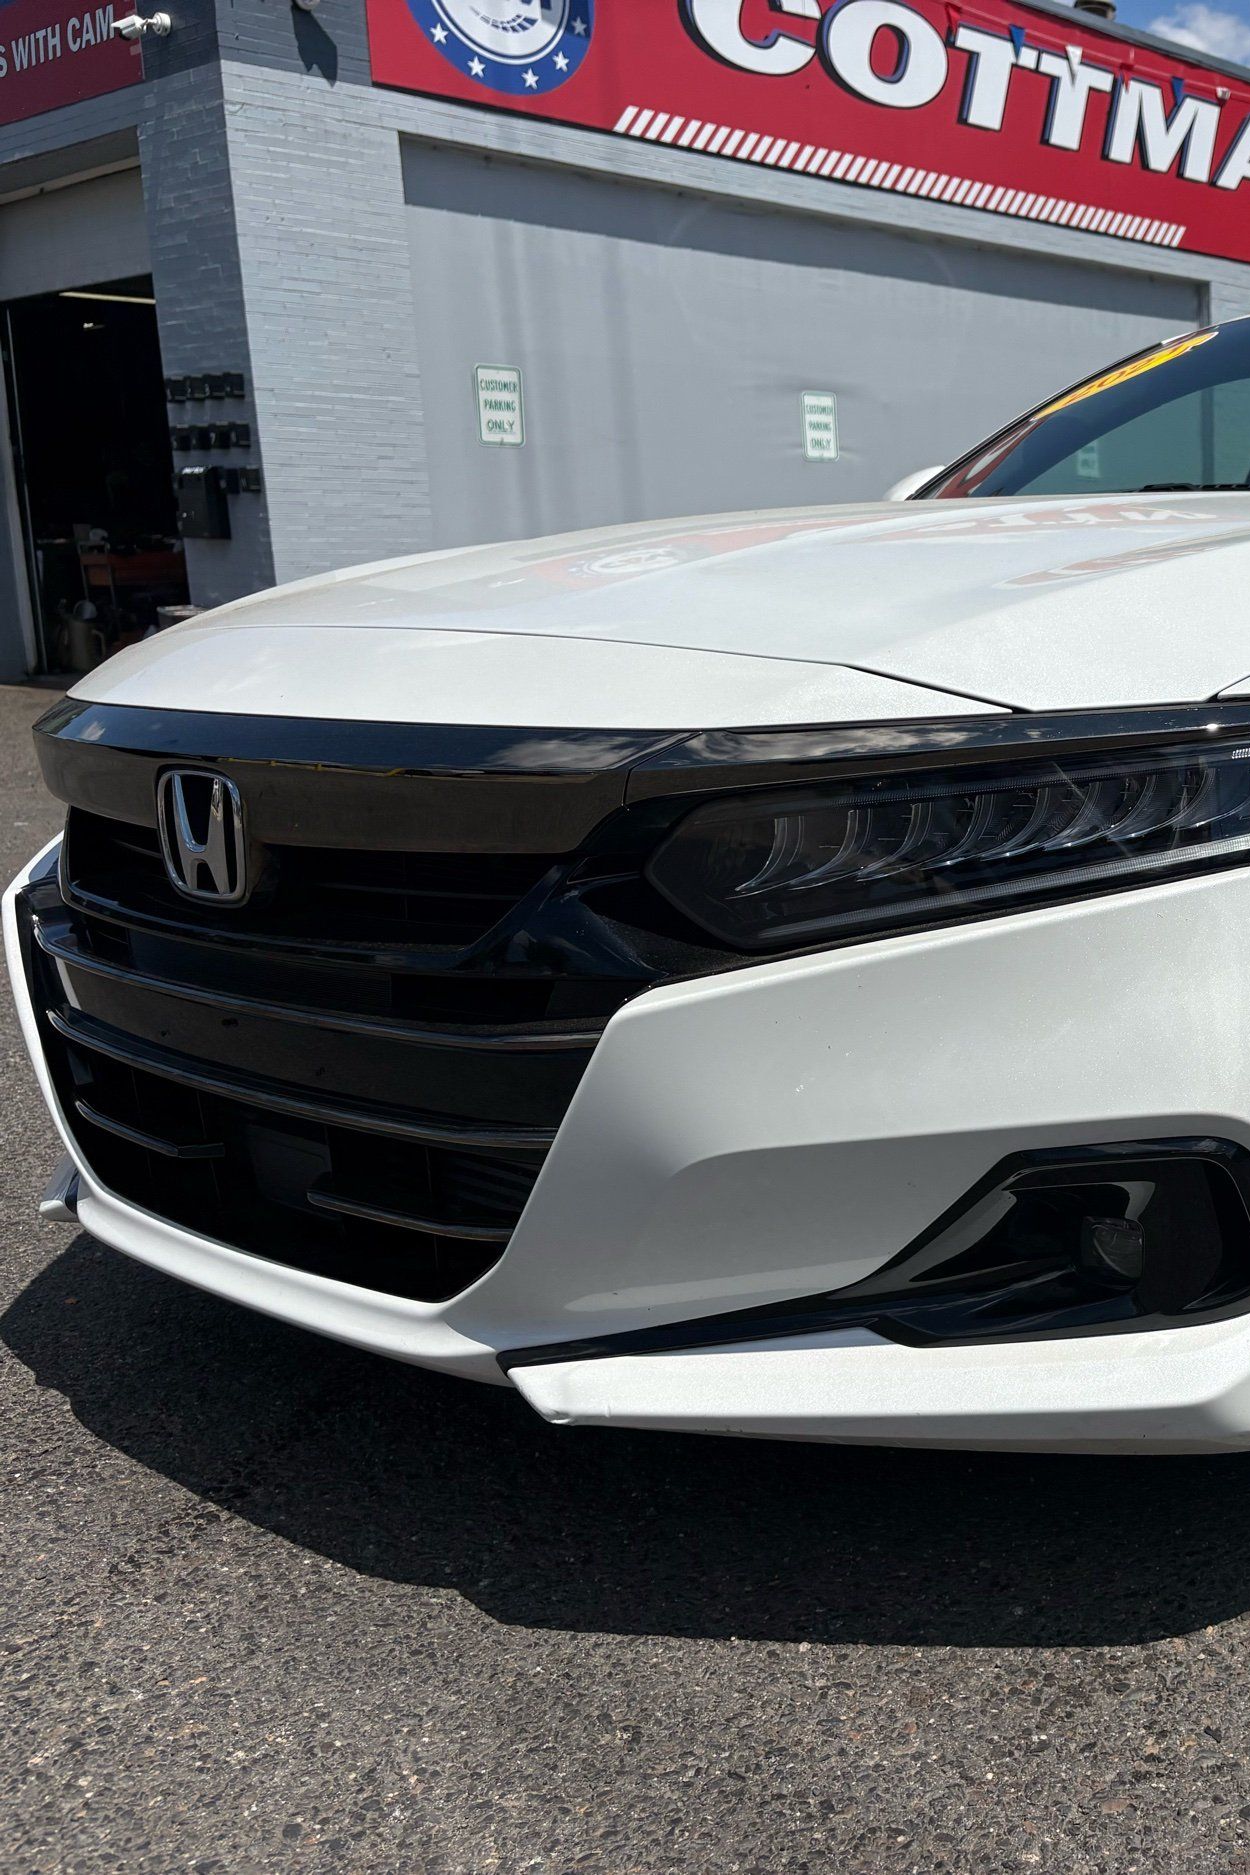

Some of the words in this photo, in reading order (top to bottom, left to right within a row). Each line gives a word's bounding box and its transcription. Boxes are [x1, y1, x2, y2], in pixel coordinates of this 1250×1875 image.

[11, 23, 62, 72] WITH
[480, 379, 518, 393] CUSTOMER
[484, 399, 516, 413] PARKING
[487, 419, 514, 432] ONLY
[810, 438, 831, 449] ONLY
